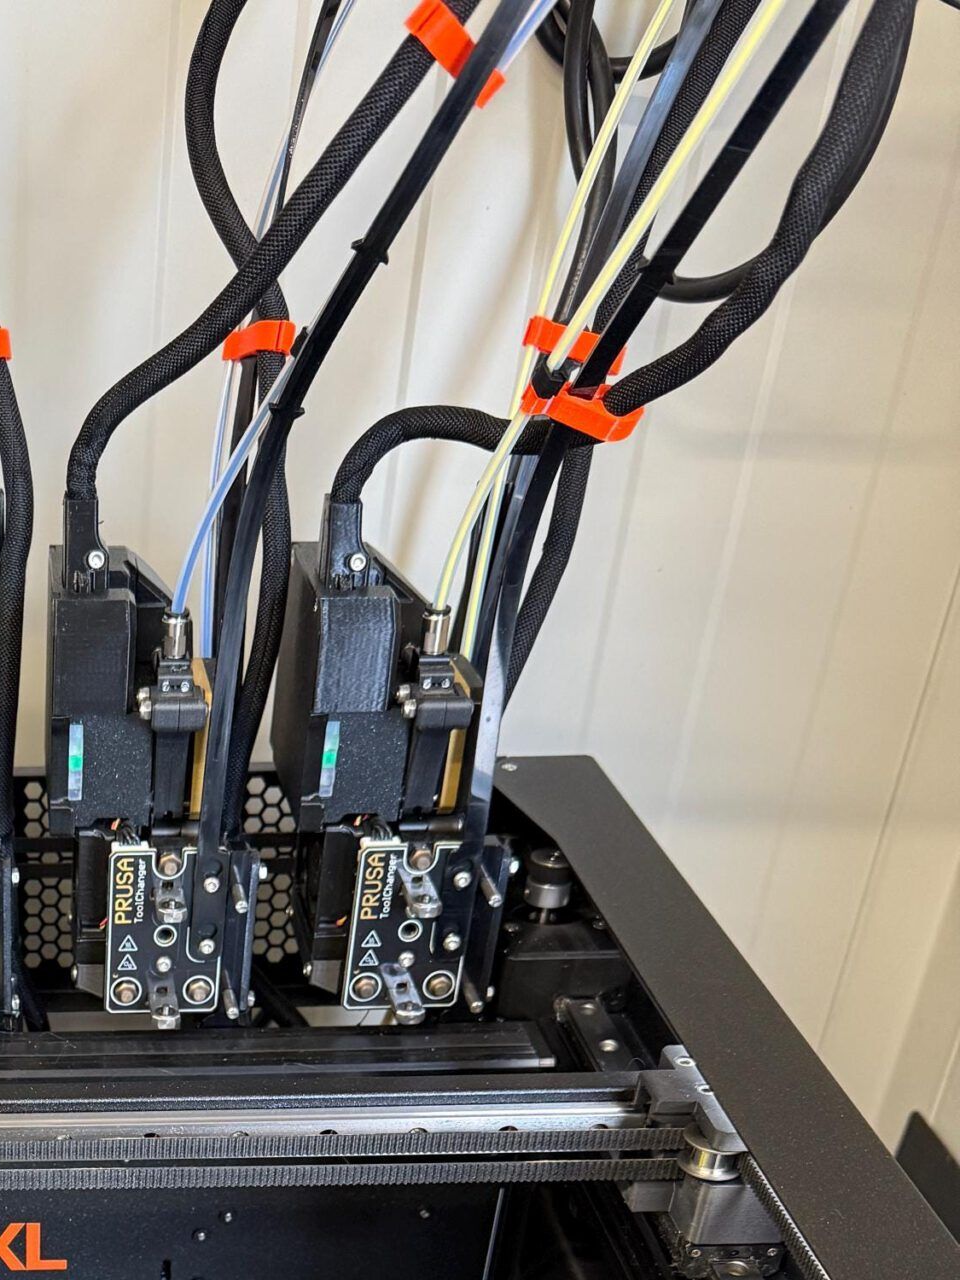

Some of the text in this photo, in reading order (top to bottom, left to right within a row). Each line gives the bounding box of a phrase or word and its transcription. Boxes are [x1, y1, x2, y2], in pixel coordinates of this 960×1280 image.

[114, 857, 135, 925] PRUSA
[134, 858, 146, 924] ToolChanger
[360, 852, 386, 920] PRUSA
[379, 853, 399, 920] ToolChanger
